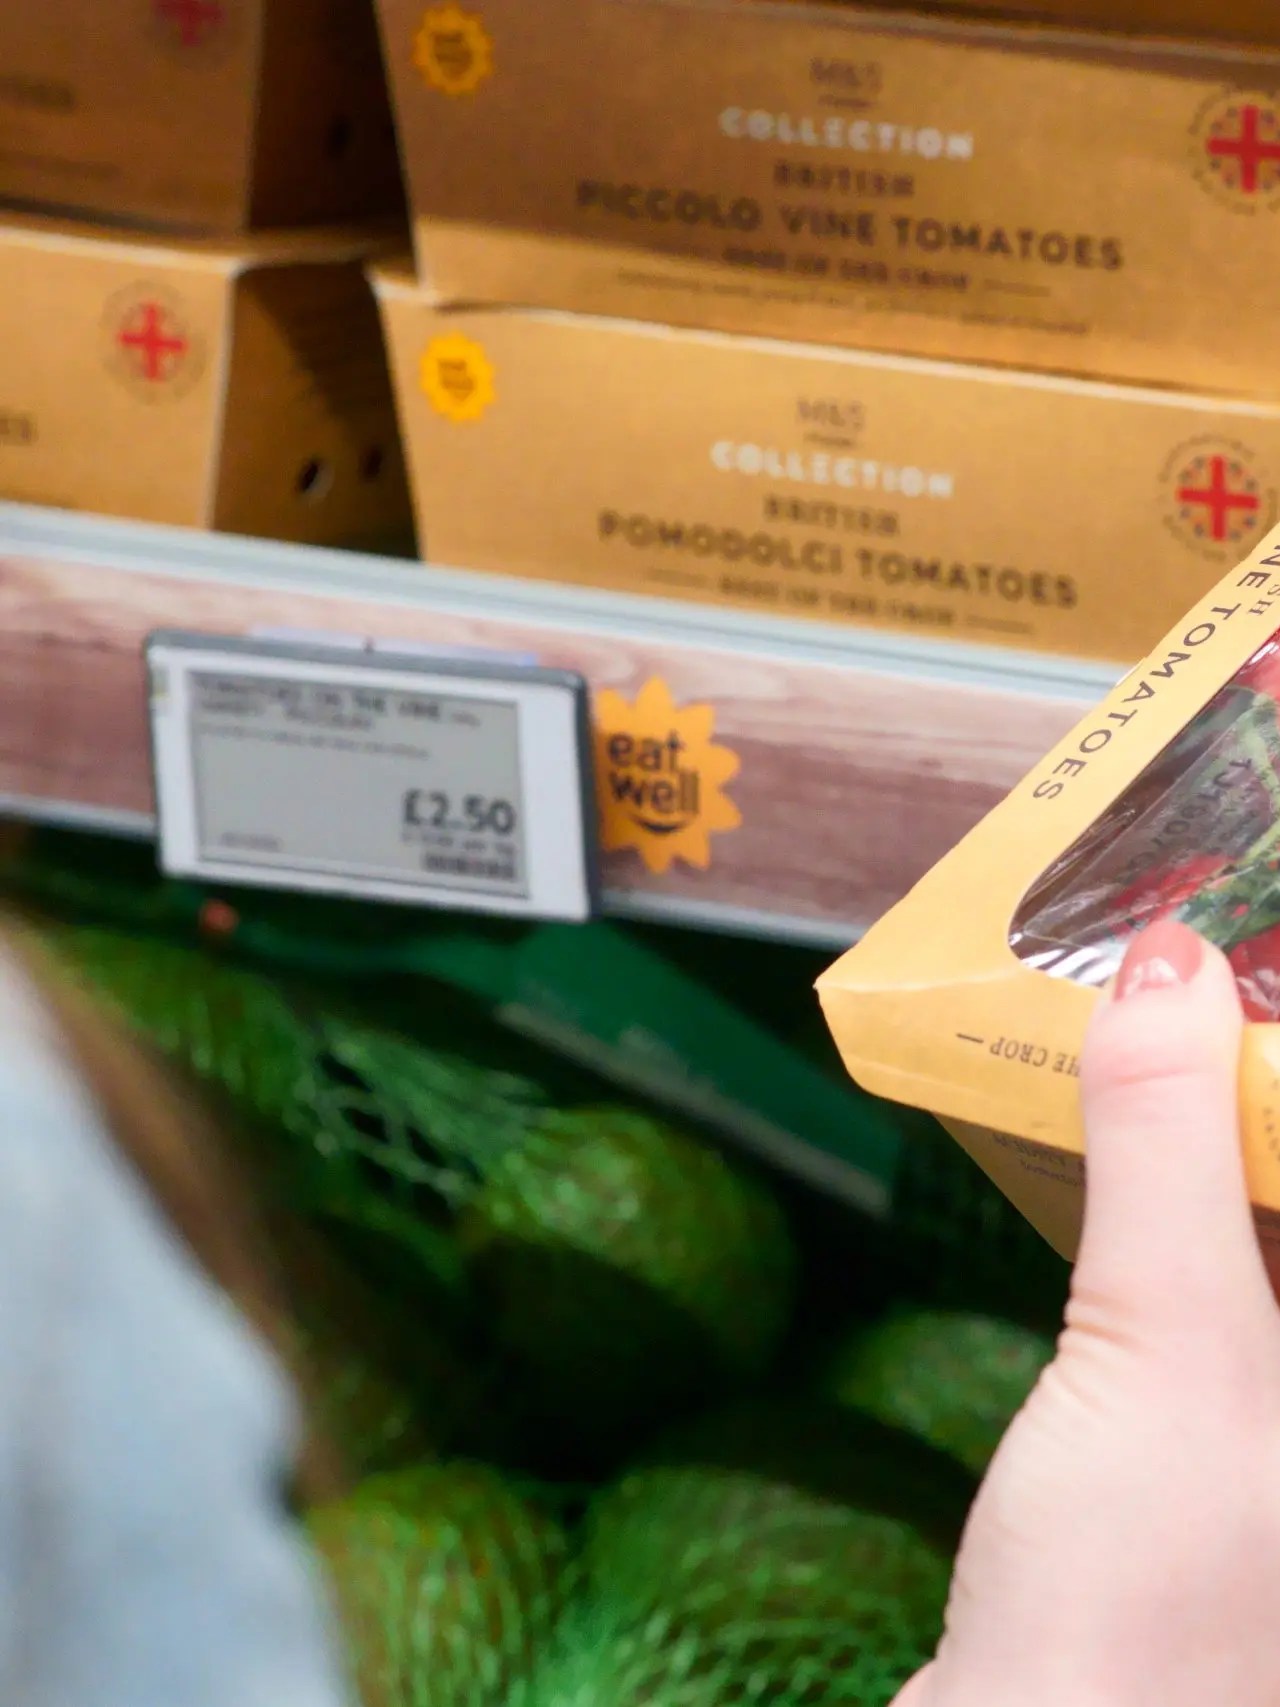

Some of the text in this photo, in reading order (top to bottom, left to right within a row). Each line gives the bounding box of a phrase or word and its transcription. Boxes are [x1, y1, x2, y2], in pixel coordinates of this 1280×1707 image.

[718, 105, 974, 160] COLLECTION
[575, 177, 762, 231] PICCOLO
[779, 206, 876, 248] VINE
[891, 216, 1125, 271] TOMATOES
[710, 439, 955, 499] COLLECTION
[598, 509, 844, 577] POMODOLCI
[858, 548, 1079, 609] TOMATOES
[1032, 602, 1242, 802] TOMATOES
[607, 728, 686, 773] eat
[403, 788, 516, 835] £2.50
[608, 769, 700, 815] well
[988, 1035, 1082, 1078] HE CROP
